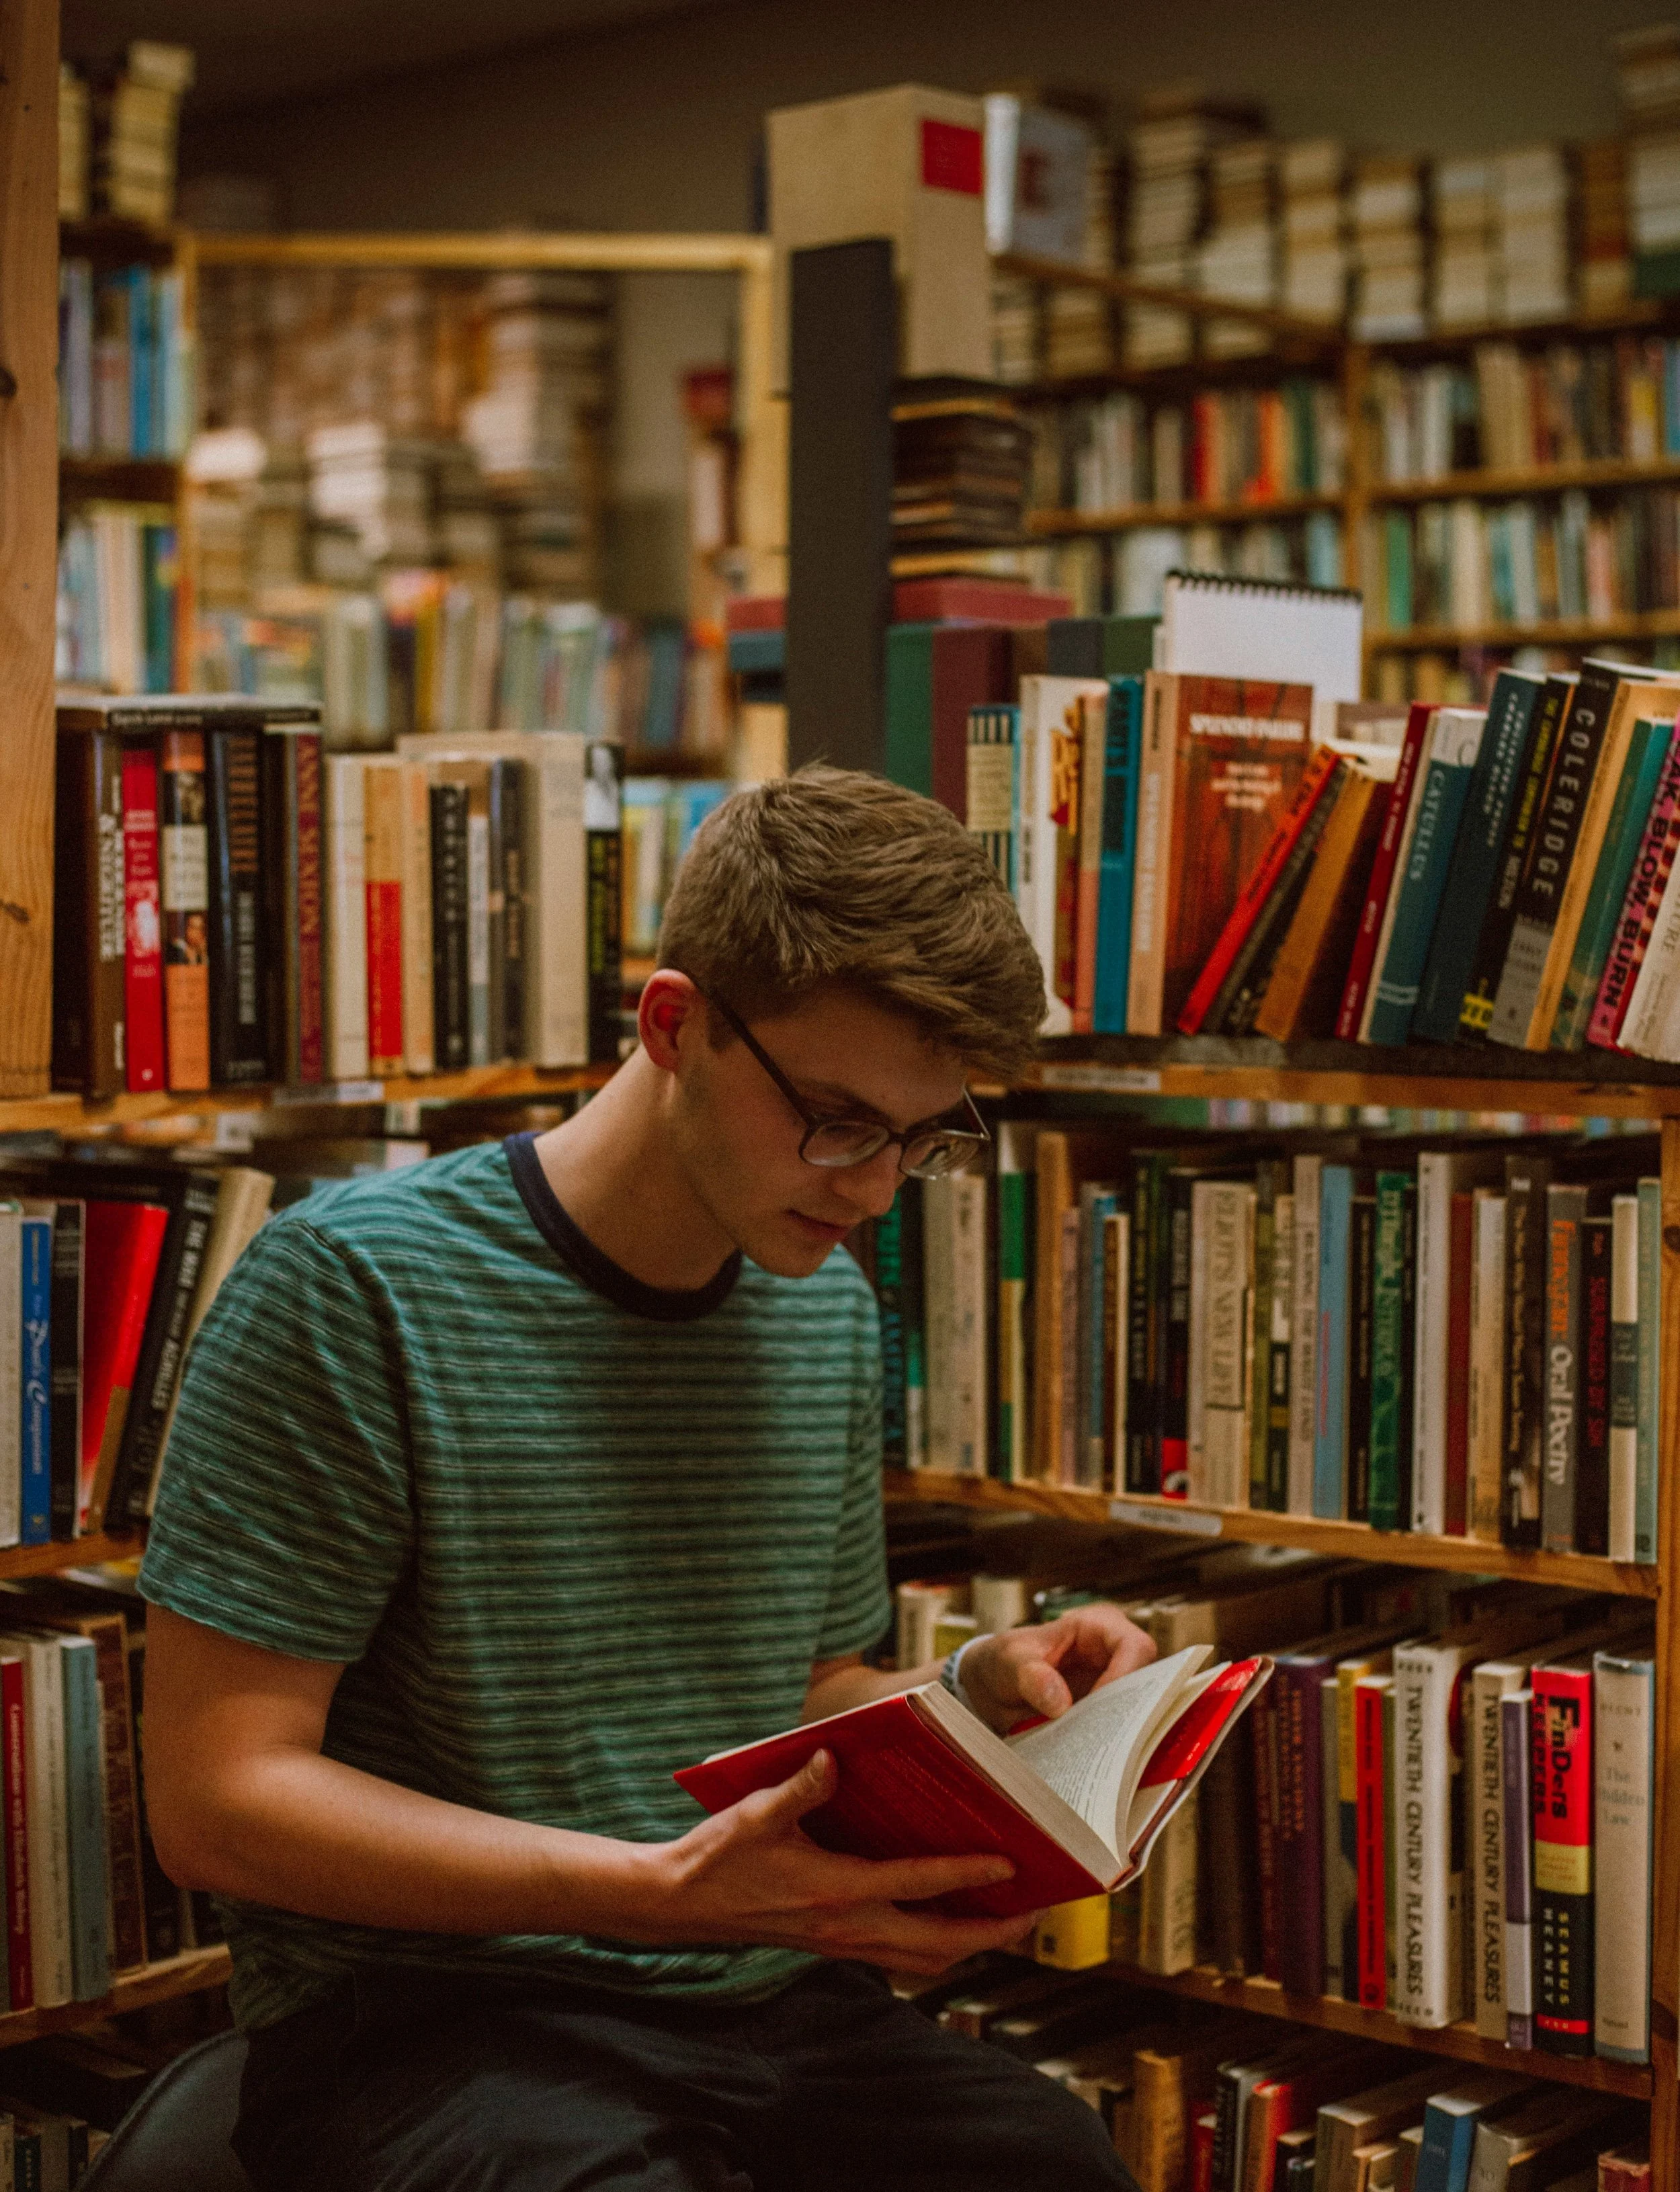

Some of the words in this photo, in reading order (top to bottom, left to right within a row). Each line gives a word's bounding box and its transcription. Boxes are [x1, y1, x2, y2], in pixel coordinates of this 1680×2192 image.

[297, 744, 320, 812] ANNE
[1411, 771, 1446, 880] CATULLUS
[1533, 708, 1596, 898] COLERIDGE
[298, 827, 323, 935] SEXTON
[1603, 917, 1641, 1007] BURN
[1548, 1345, 1573, 1400] Oral
[1547, 1404, 1572, 1486] Poetry
[1404, 1684, 1424, 1792] TWENTIETH
[1482, 1693, 1501, 1799] TWENTIETH
[1532, 1693, 1546, 1814] KEEPERS
[1404, 1800, 1424, 1884] CENTURY
[1482, 1808, 1501, 1891] CENTURY
[1404, 1892, 1424, 1996] PLEASURES
[1482, 1900, 1502, 2003] PLEASURES
[1543, 1907, 1554, 2005] HEANEY
[1558, 1911, 1569, 2005] SEAMUS
